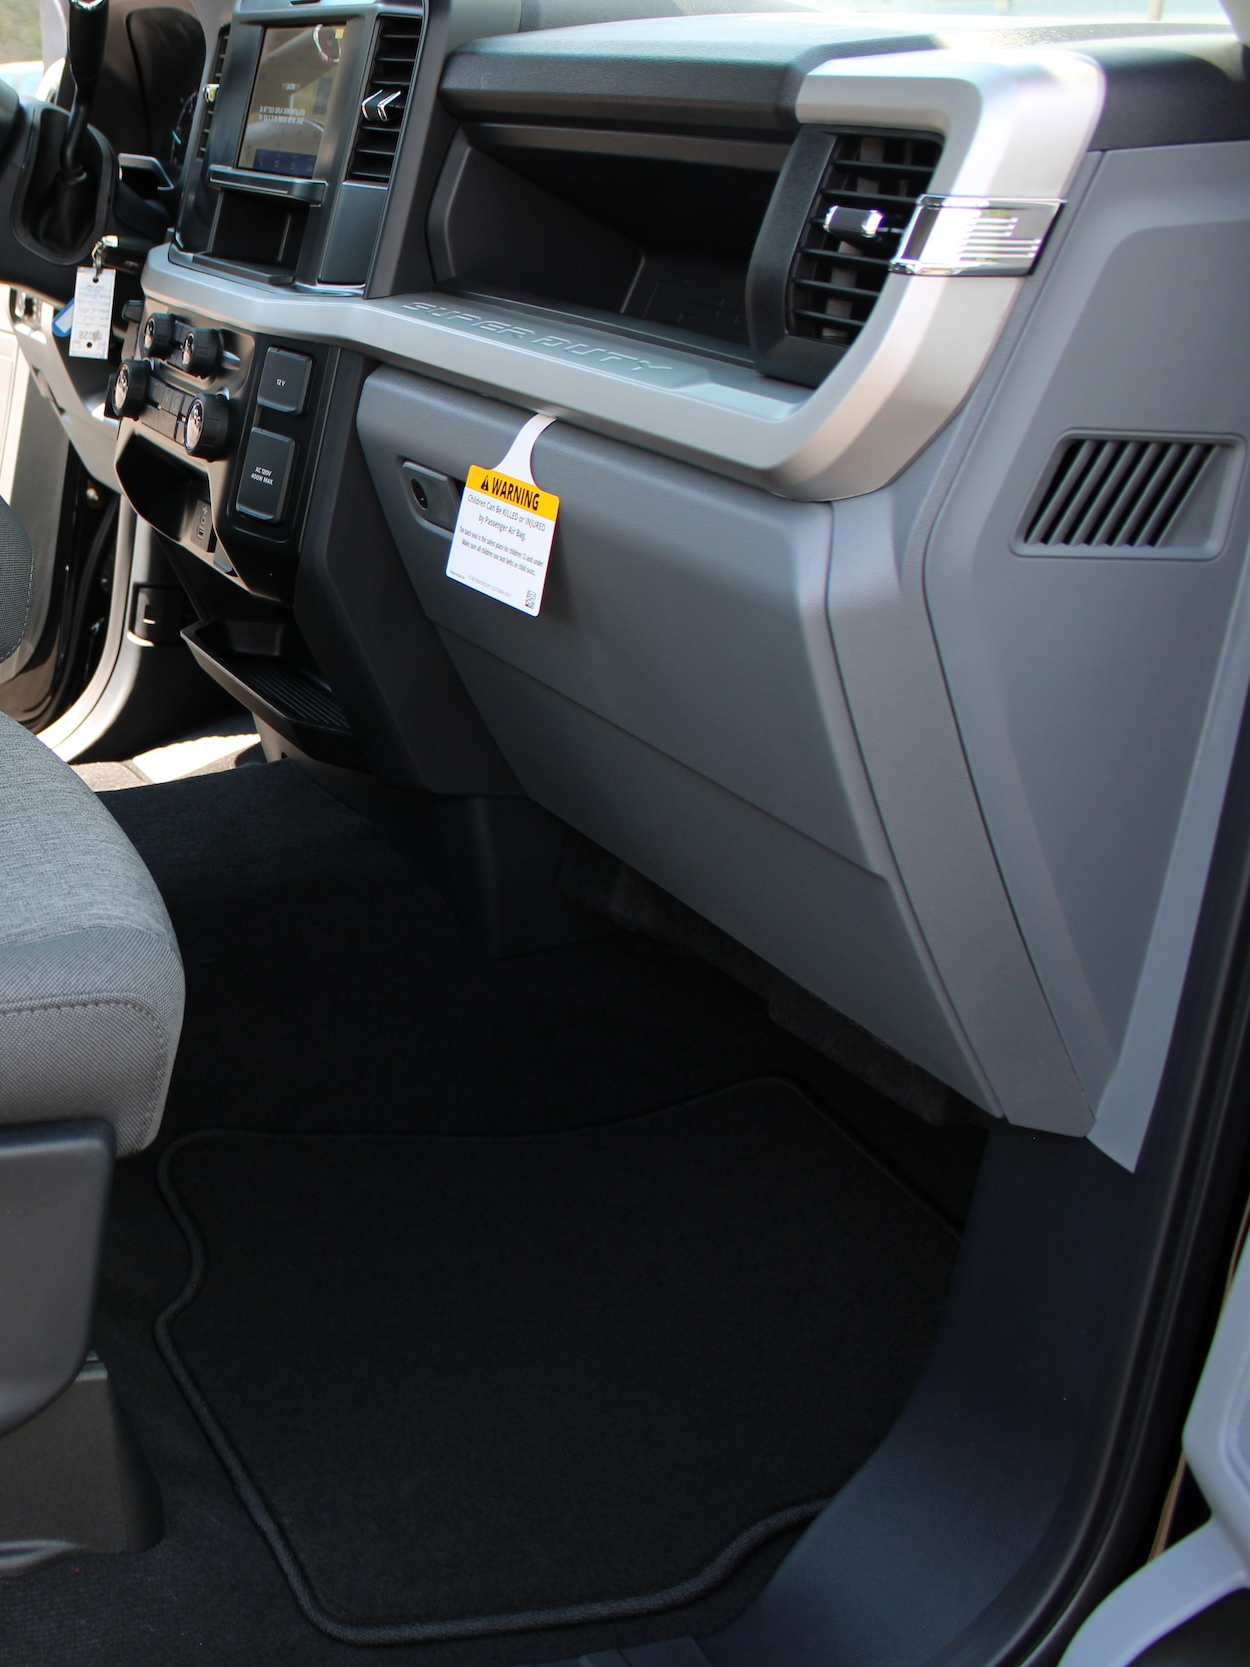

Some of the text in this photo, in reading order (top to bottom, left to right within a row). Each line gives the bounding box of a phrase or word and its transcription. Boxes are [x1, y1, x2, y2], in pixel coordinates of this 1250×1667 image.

[402, 301, 673, 371] SUPER DUTY
[263, 476, 274, 486] MAX
[491, 477, 540, 511] WARNING
[478, 514, 485, 524] by
[484, 517, 508, 534] Passenger
[508, 526, 516, 535] Air
[486, 502, 496, 512] Can
[496, 506, 502, 514] Be
[502, 508, 519, 521] KILLED
[525, 517, 546, 533] INJURED
